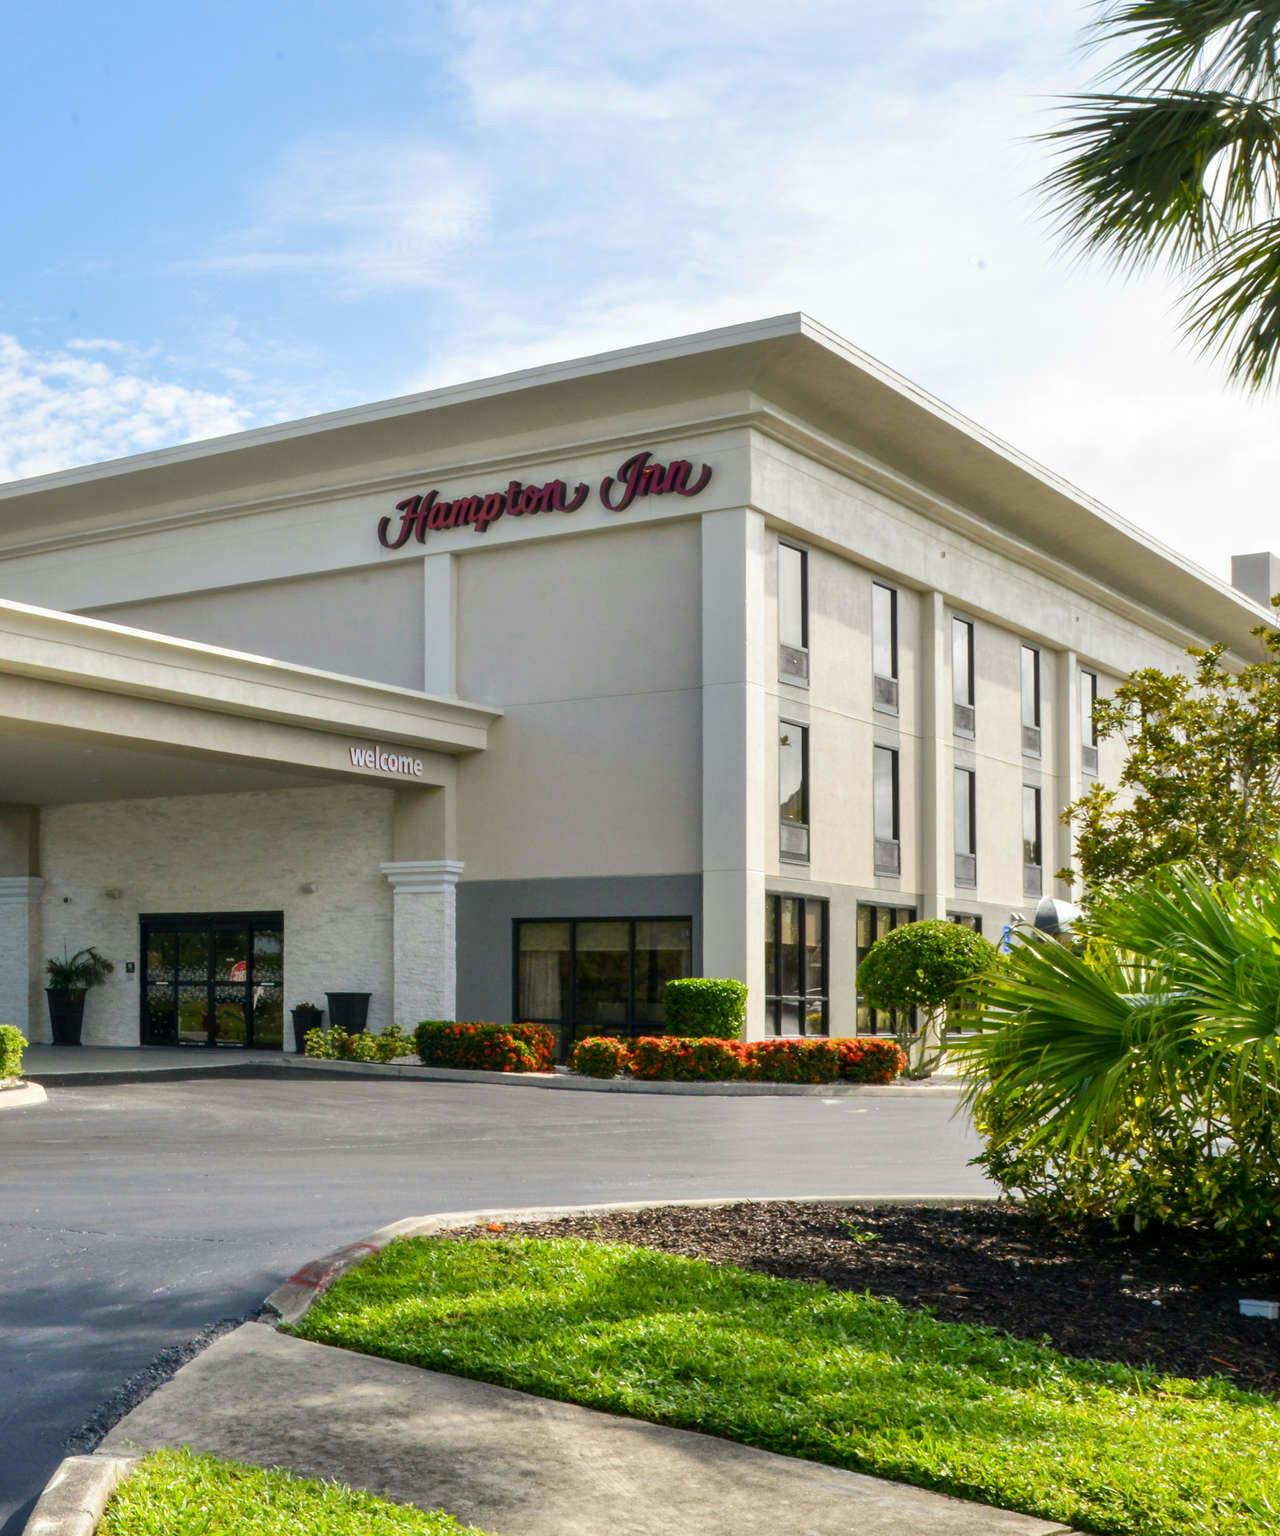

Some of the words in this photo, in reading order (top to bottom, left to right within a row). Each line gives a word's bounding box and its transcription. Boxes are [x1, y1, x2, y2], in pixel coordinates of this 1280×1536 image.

[377, 479, 590, 550] Hampton
[599, 451, 713, 512] Inn
[349, 745, 423, 776] welcome
